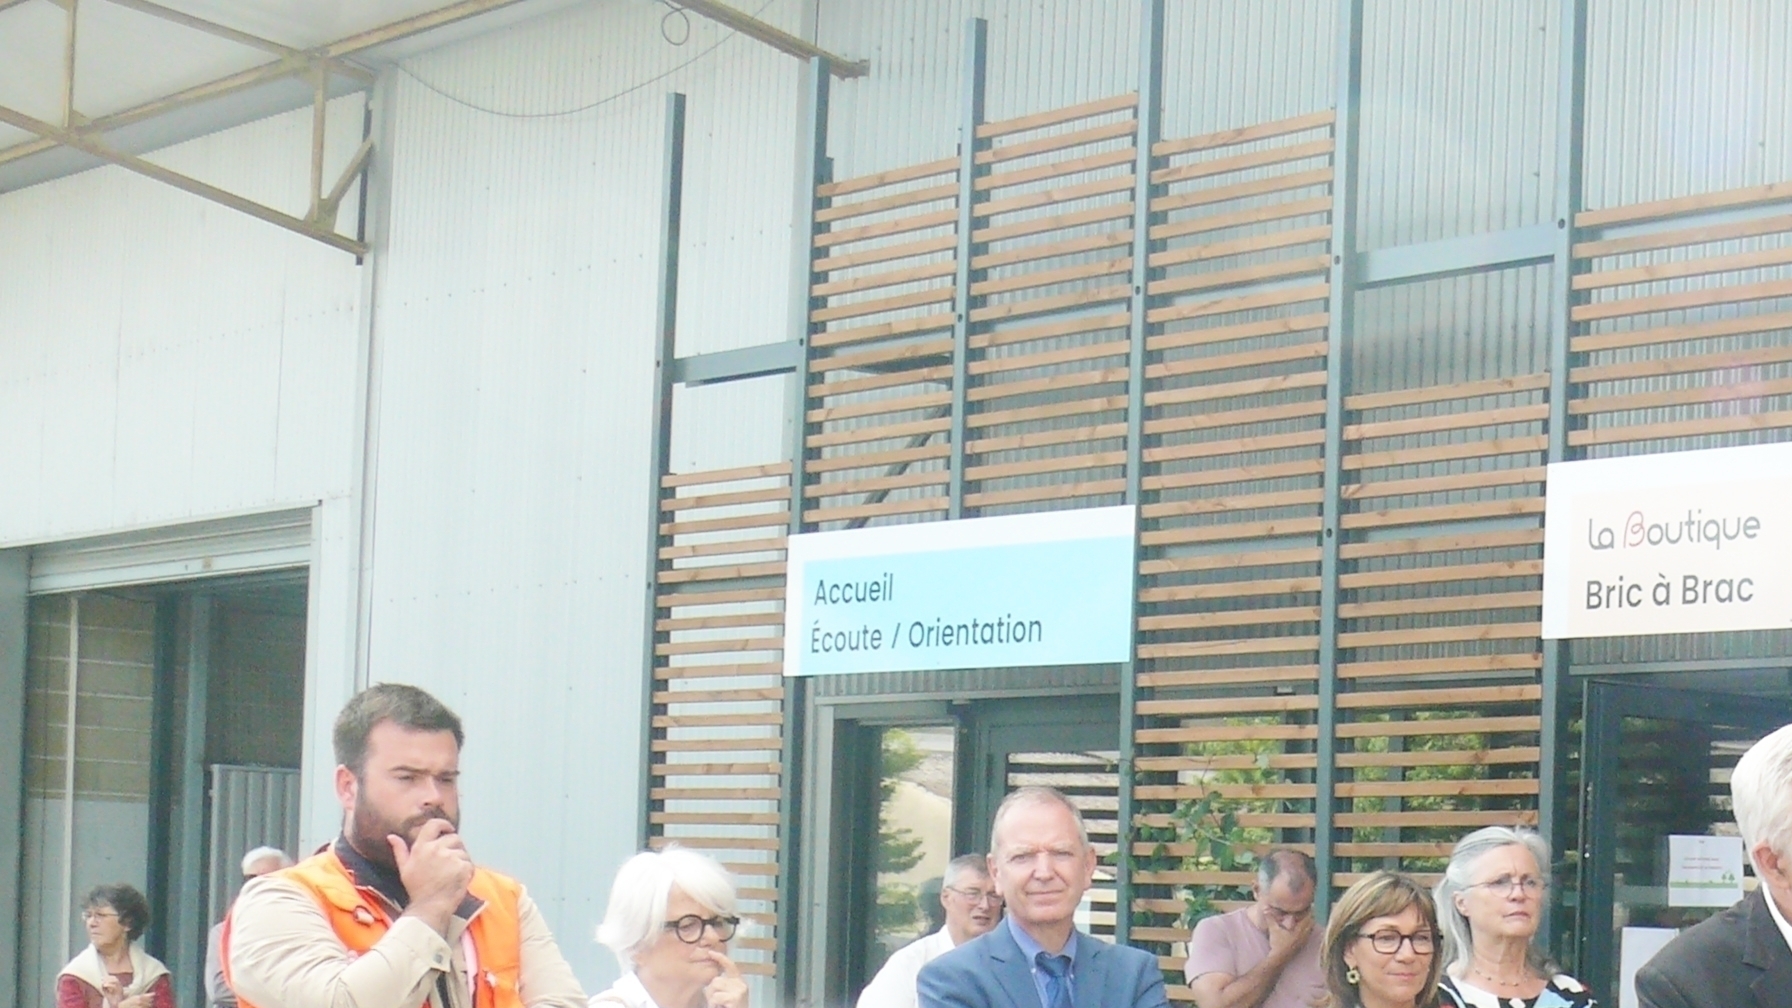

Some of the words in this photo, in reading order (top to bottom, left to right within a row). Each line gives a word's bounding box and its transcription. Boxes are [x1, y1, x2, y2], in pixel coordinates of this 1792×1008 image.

[1623, 509, 1761, 551] Boutique
[814, 572, 893, 606] Accueil
[1586, 575, 1643, 610] Bric
[1652, 572, 1671, 606] à
[1681, 574, 1754, 605] Brac
[811, 620, 882, 653] Écoute
[891, 622, 900, 649] /
[908, 613, 1043, 648] Orientation
